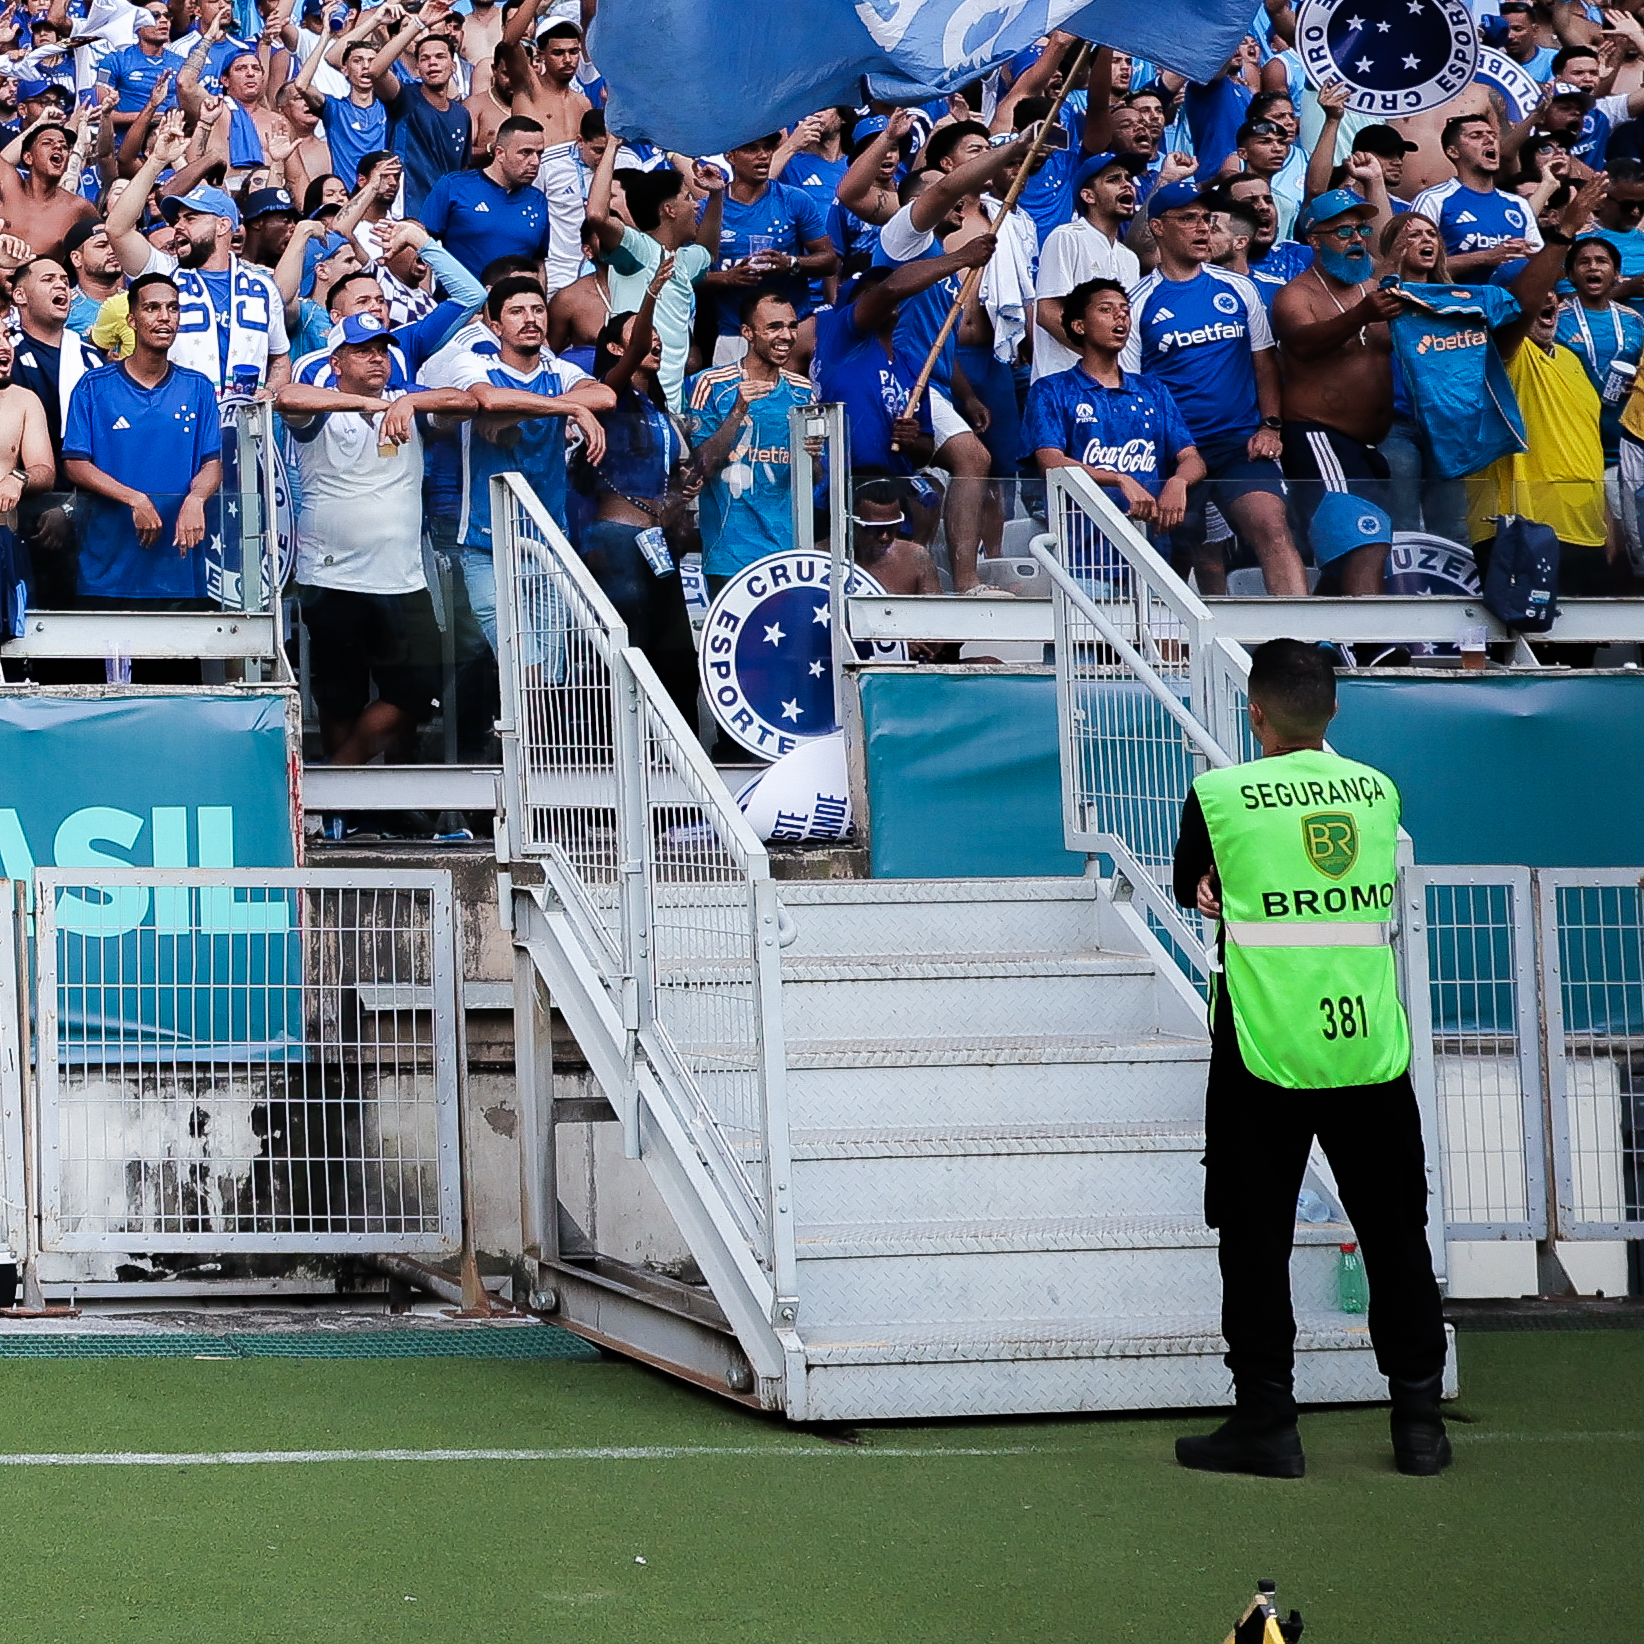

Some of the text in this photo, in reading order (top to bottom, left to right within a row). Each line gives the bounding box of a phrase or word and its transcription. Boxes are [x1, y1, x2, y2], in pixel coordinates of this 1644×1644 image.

[1172, 320, 1247, 350] betfair
[1430, 328, 1488, 354] betfa
[709, 609, 797, 756] ESPORTE
[1241, 776, 1386, 810] SEGURANÇA
[1309, 821, 1354, 859] BR
[1262, 882, 1395, 918] BROMO
[1318, 994, 1369, 1042] 381
